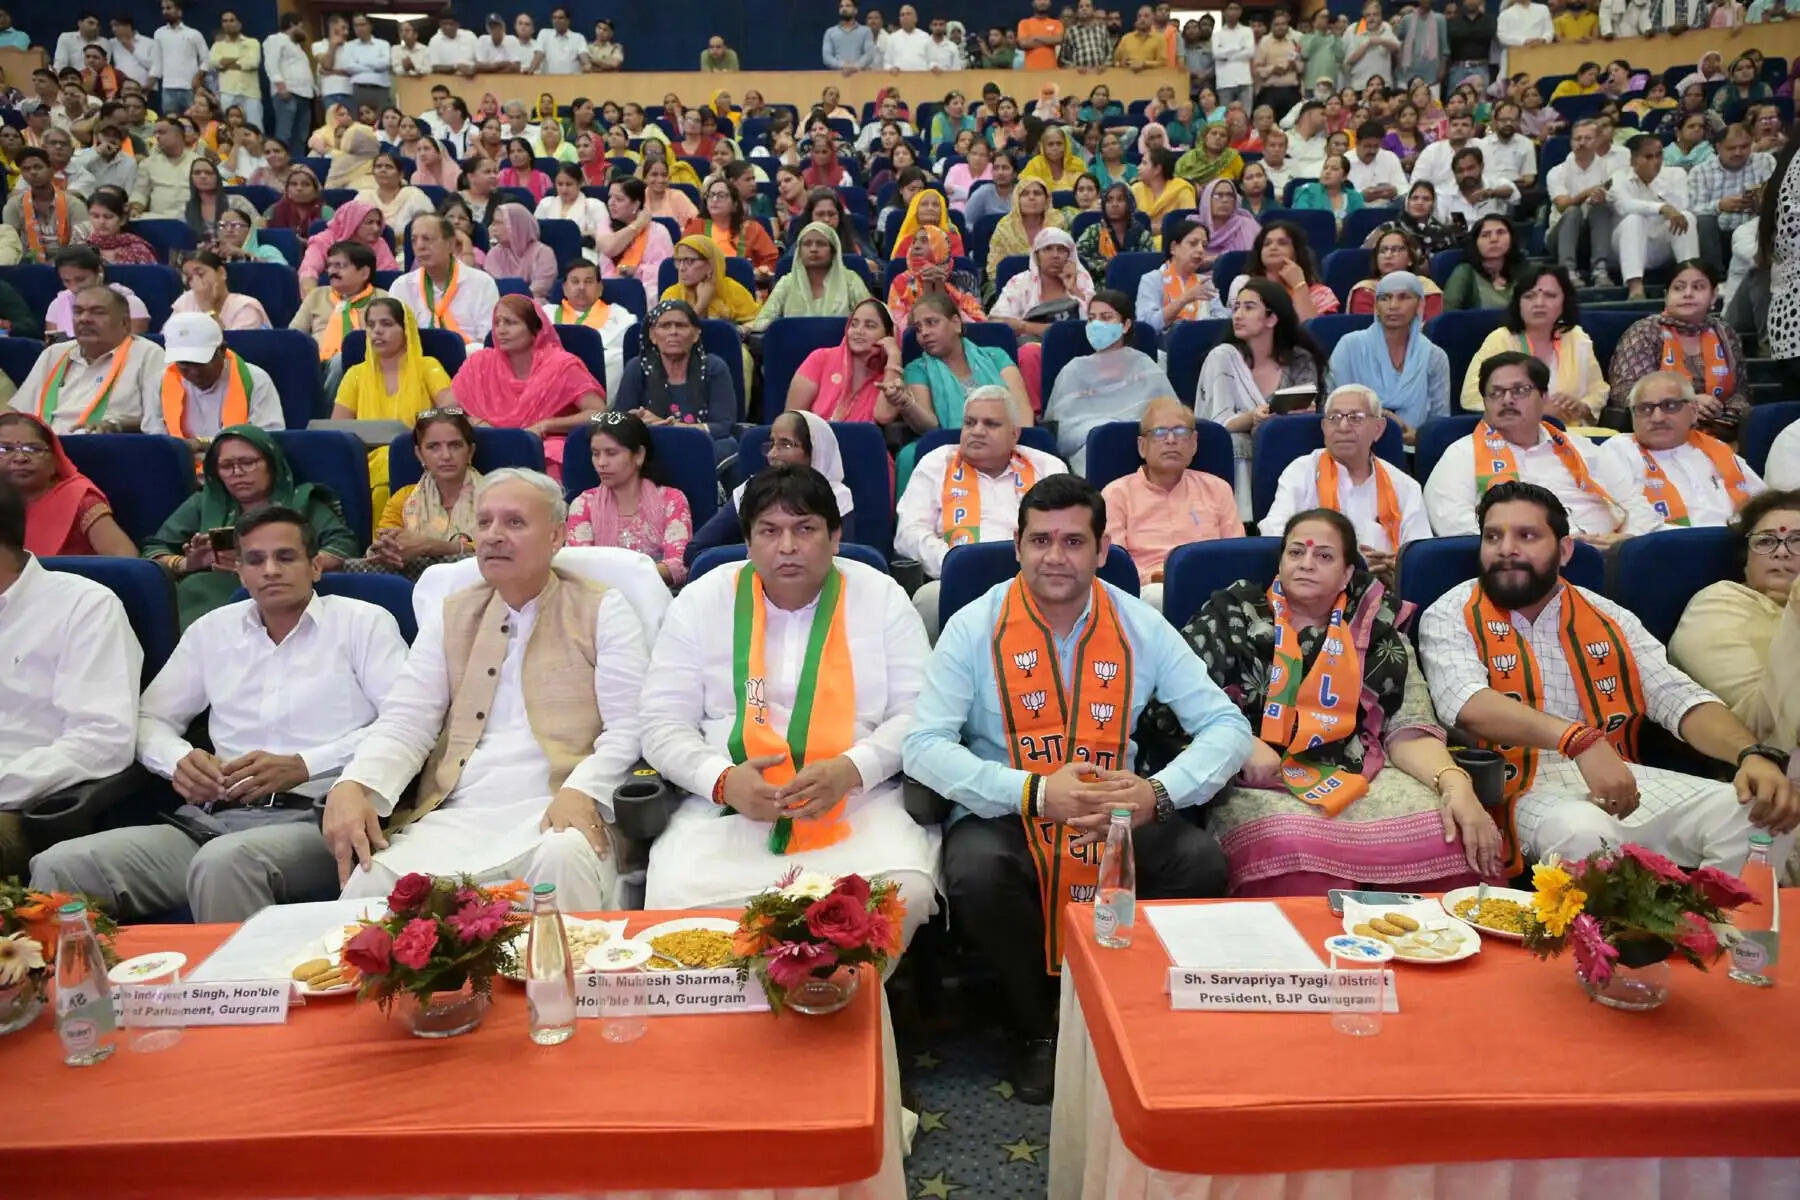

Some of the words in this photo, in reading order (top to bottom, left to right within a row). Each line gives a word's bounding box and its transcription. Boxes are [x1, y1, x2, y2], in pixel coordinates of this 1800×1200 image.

[1493, 460, 1505, 473] P
[955, 508, 966, 524] P
[675, 974, 735, 986] Sharma,
[1184, 973, 1206, 985] Sh.
[1210, 974, 1286, 987] Sarvapriya
[191, 988, 230, 1001] Singh,
[233, 987, 281, 998] Hon'ble
[674, 993, 747, 1006] Gurugram
[1199, 992, 1272, 1005] President,
[1275, 993, 1303, 1005] BJP
[218, 1004, 281, 1016] Gurugram
